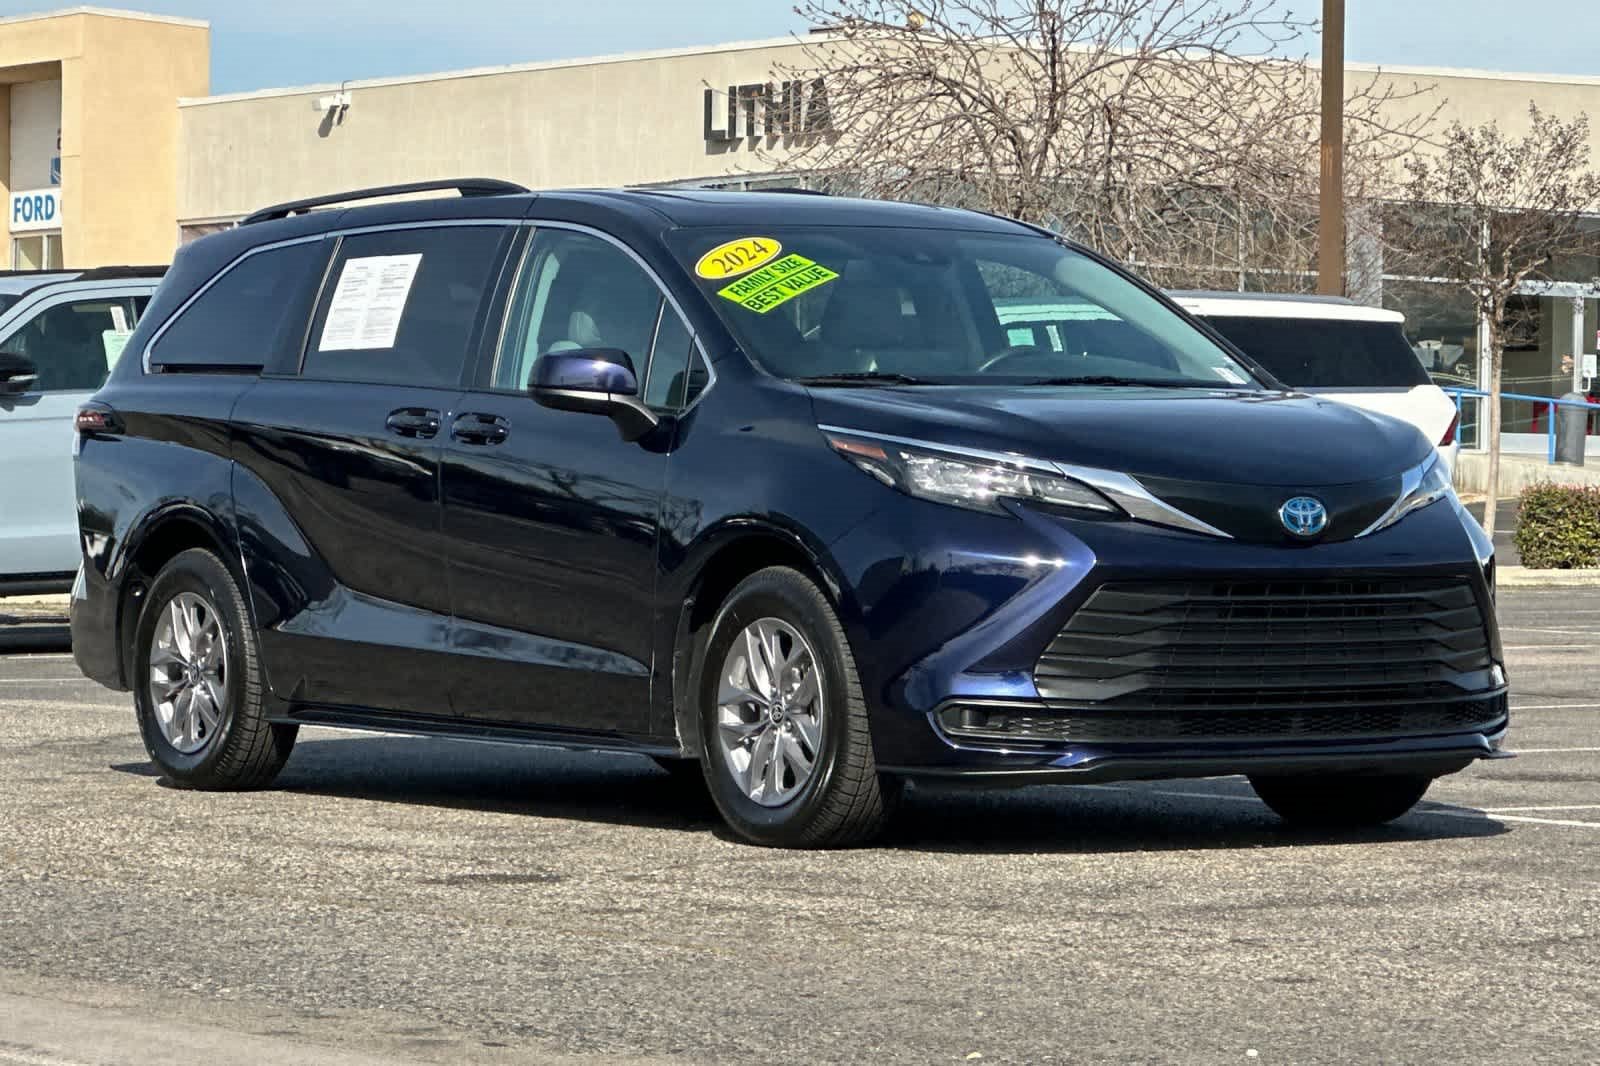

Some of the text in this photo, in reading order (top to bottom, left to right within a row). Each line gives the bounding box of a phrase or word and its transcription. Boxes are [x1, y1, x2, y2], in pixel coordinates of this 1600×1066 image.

[704, 78, 834, 140] LITHIA
[13, 194, 55, 223] FORD
[712, 240, 769, 274] 2024
[728, 256, 803, 297] FAMILY SIZE
[745, 267, 830, 311] BEST VALUE
